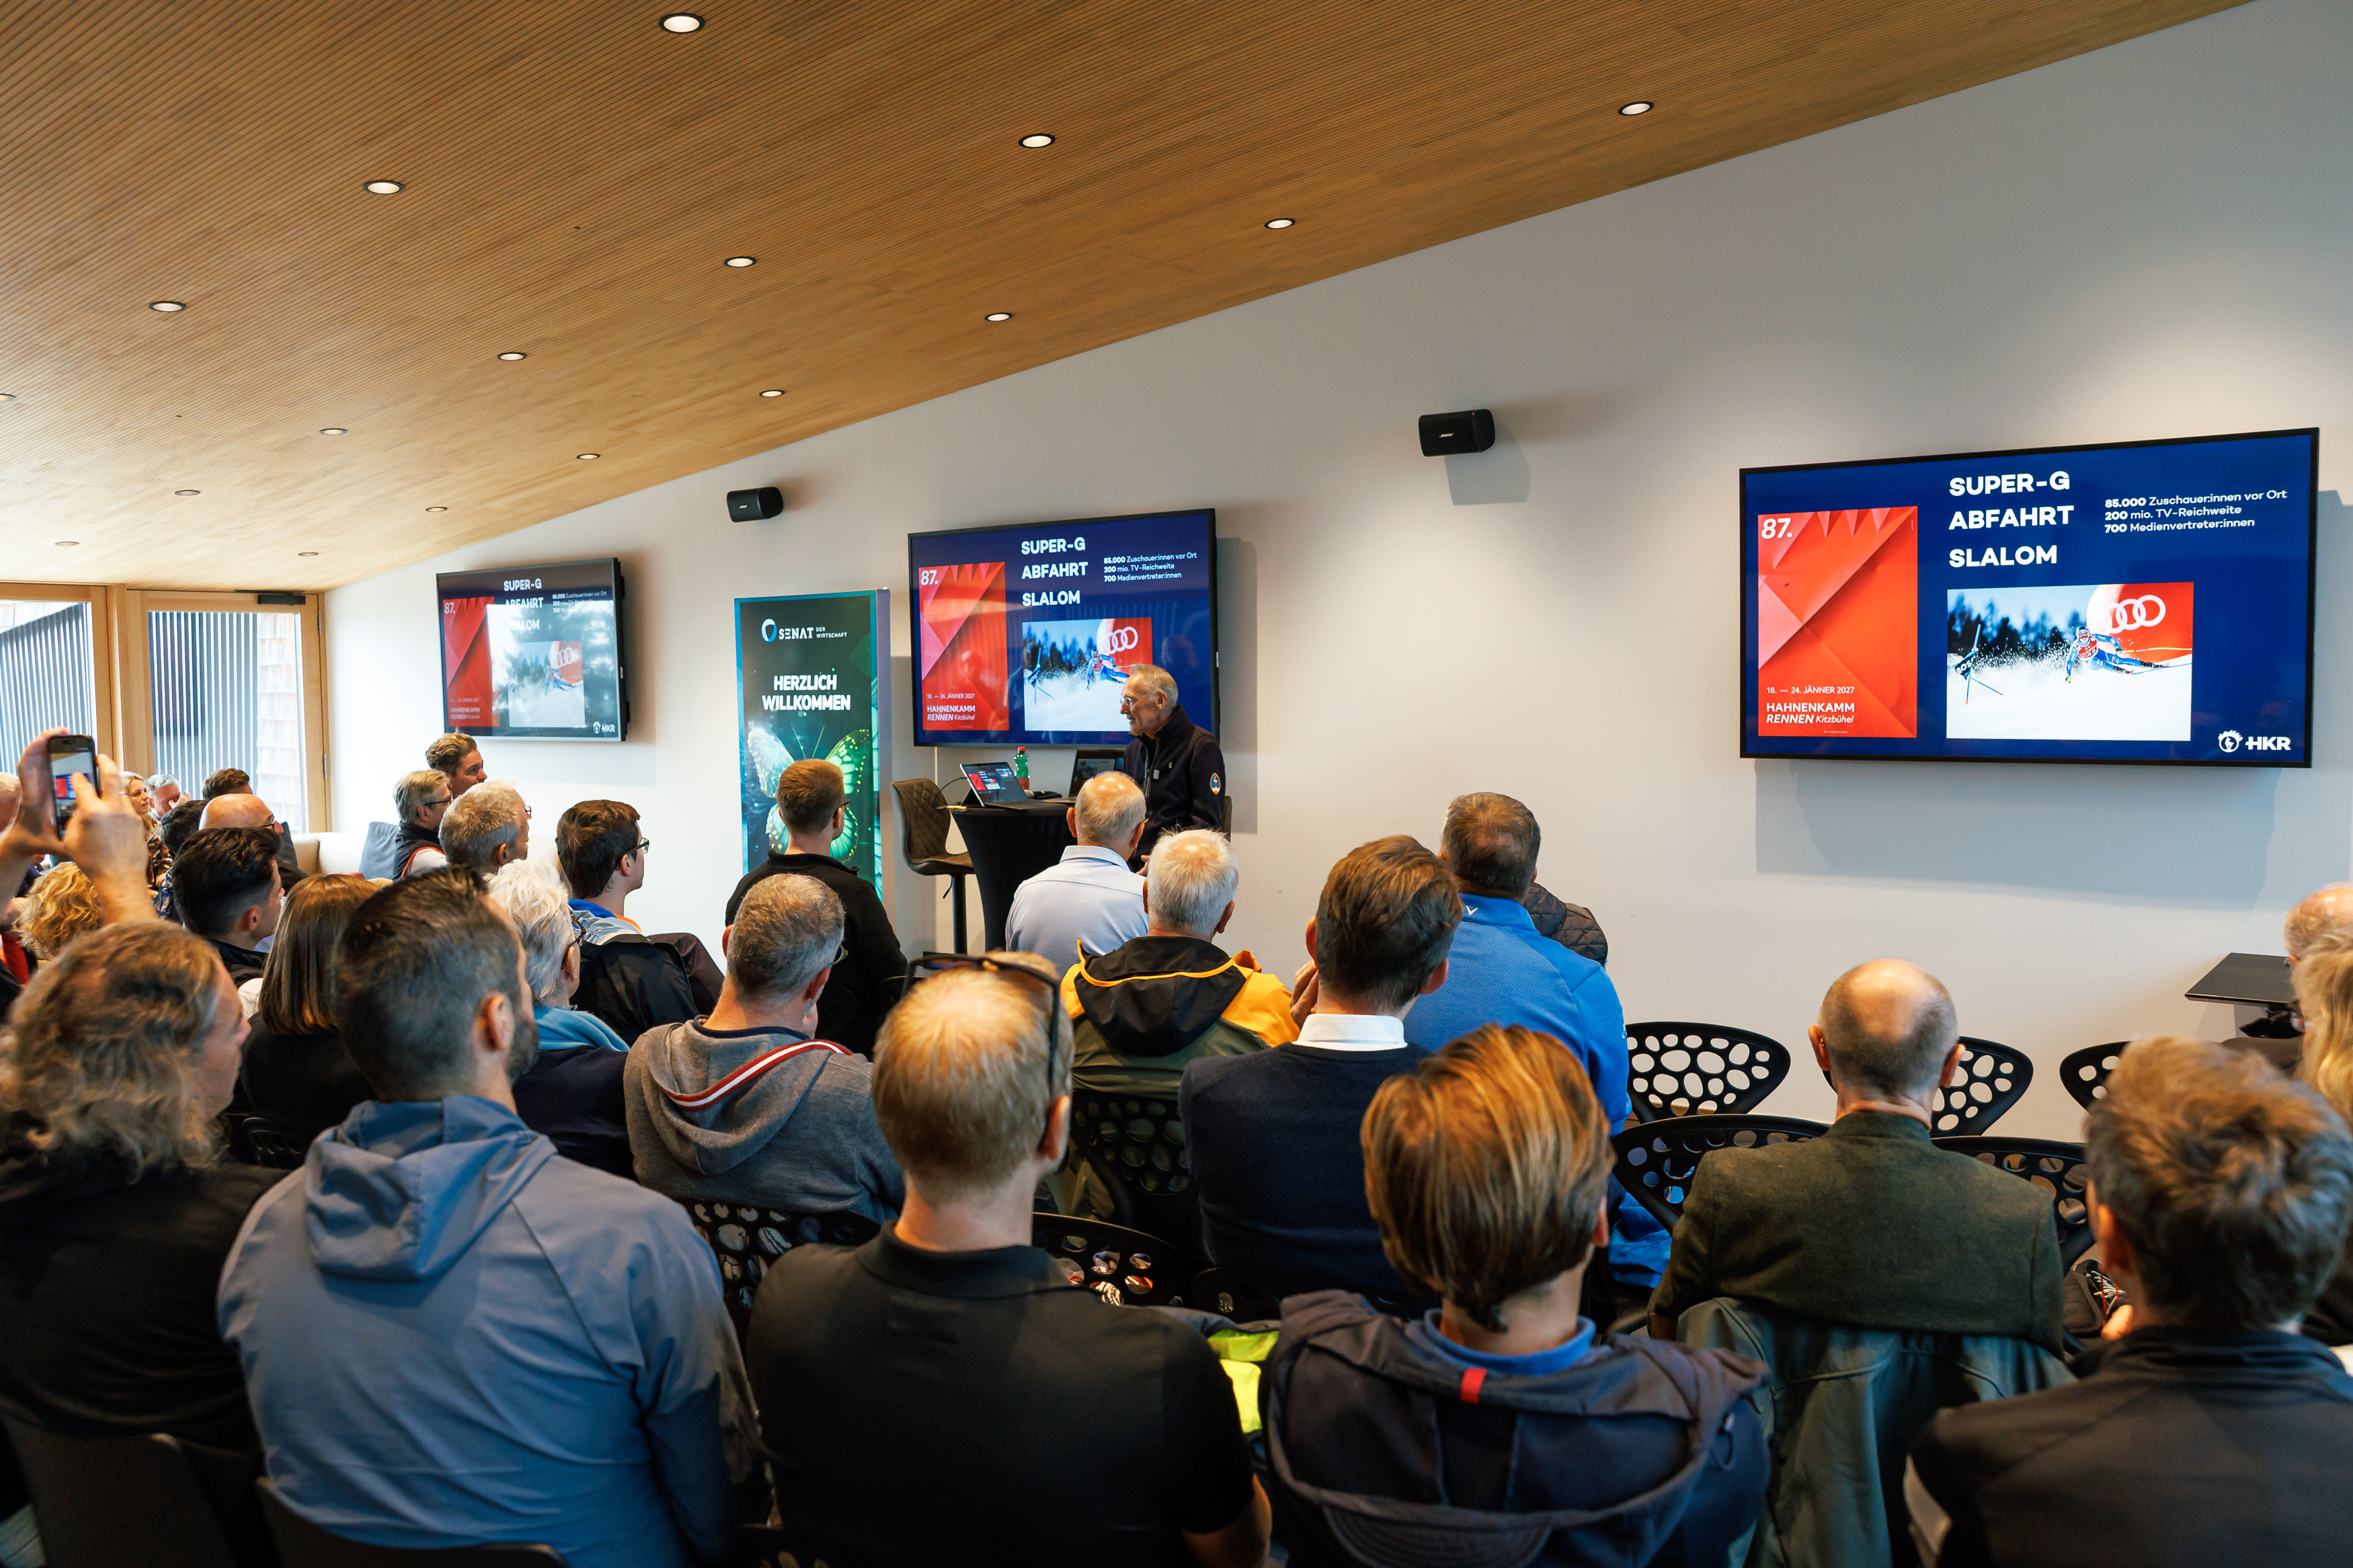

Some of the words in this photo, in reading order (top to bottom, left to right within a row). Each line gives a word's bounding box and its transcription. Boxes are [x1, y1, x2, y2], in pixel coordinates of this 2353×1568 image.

[1949, 470, 2070, 497] SUPER-G
[2104, 497, 2147, 508] 85.000
[2149, 493, 2241, 505] Zuschauer:innen
[2244, 493, 2264, 501] vor
[2266, 490, 2288, 499] Ort
[1949, 505, 2074, 530] ABFAHRT
[2104, 511, 2128, 521] 200
[2130, 510, 2153, 520] mio.
[2155, 505, 2242, 518] TV-Reichweite
[1761, 518, 1793, 540] 87.
[2104, 524, 2128, 534] 700
[2130, 518, 2256, 532] Medienvertreter:innen
[1021, 536, 1086, 554] SUPER-G
[1103, 556, 1126, 565] 85.000
[1126, 554, 1174, 563] Zuschauer:innen
[1949, 544, 2057, 568] SLALOM
[1021, 561, 1088, 579] ABFAHRT
[1130, 563, 1175, 571] TV-Reichweite
[503, 577, 543, 591] SUPER-G
[920, 569, 939, 586] 87.
[1117, 572, 1182, 581] Medienvertreter:innen
[1022, 590, 1081, 607] SLALOM
[444, 602, 456, 614] 87.
[779, 627, 814, 640] SENAT
[774, 674, 837, 692] HERZLICH
[1803, 685, 1835, 694] JÄNNER
[1837, 686, 1855, 694] 2027
[762, 694, 851, 711] WILLKOMMEN
[1766, 702, 1855, 712] HAHNENKAMM
[1766, 714, 1814, 724] RENNEN
[1815, 714, 1854, 724] Kitzbühel
[2245, 736, 2291, 751] HKR
